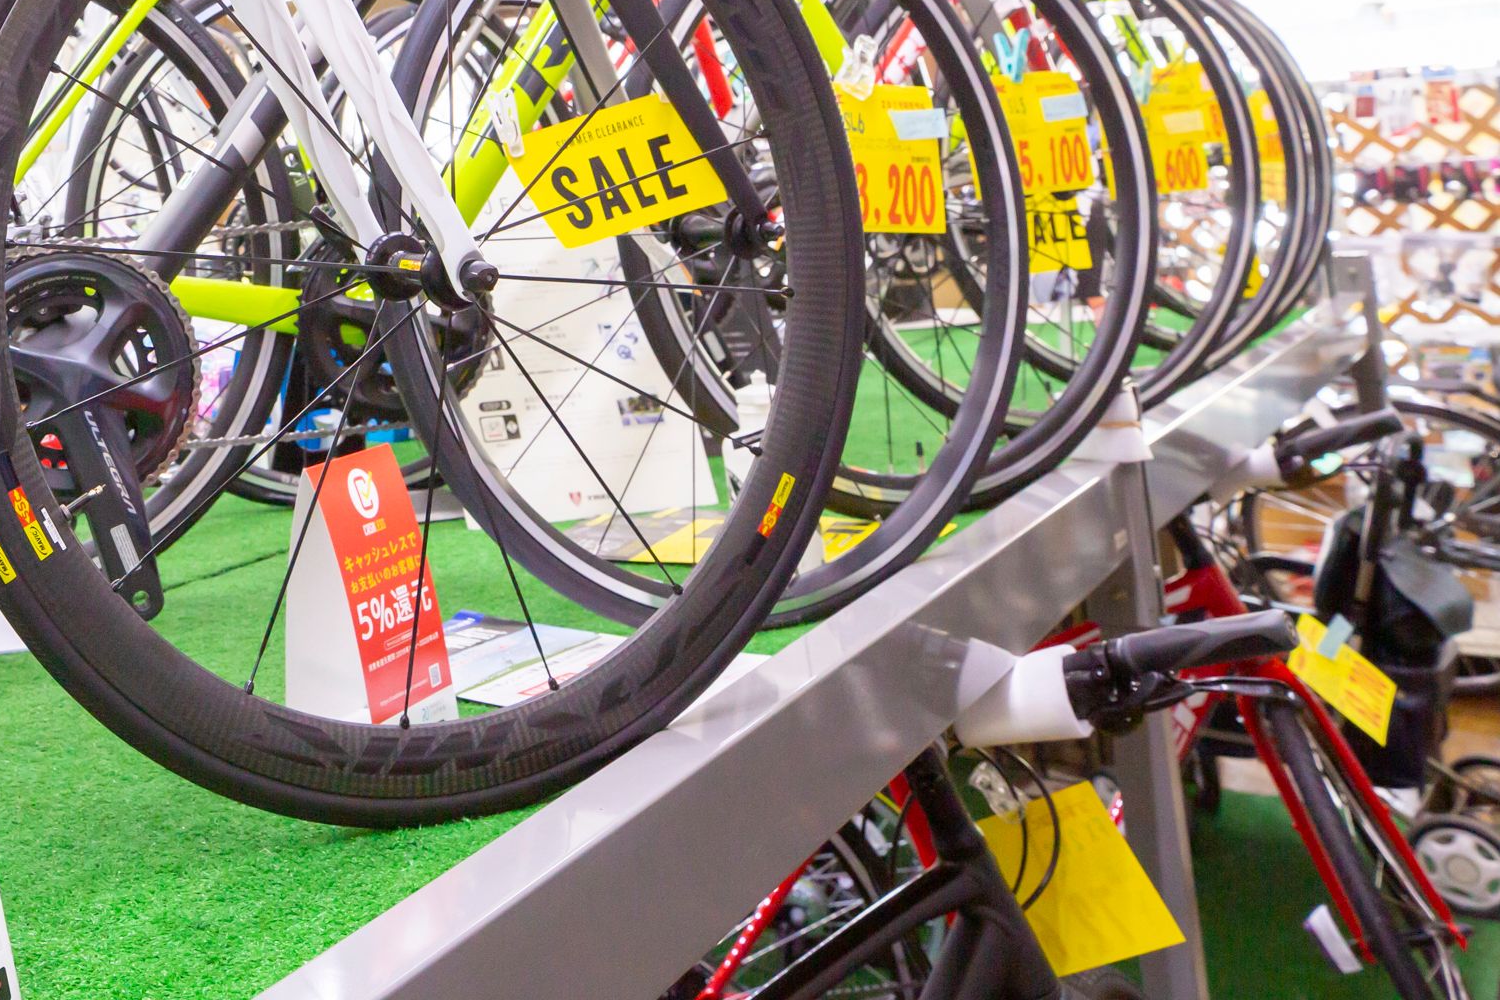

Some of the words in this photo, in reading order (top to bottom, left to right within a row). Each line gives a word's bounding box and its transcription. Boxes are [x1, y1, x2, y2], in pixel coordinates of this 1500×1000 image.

[556, 128, 594, 148] SUMER
[596, 114, 645, 140] CLEARANCE
[551, 134, 688, 231] SALE
[1034, 210, 1088, 246] ALE
[83, 410, 138, 515] ULTEGRA
[344, 531, 417, 571] キャッシュレスで
[350, 554, 422, 595] お支払いのお客様に
[356, 577, 433, 642] 5%還元
